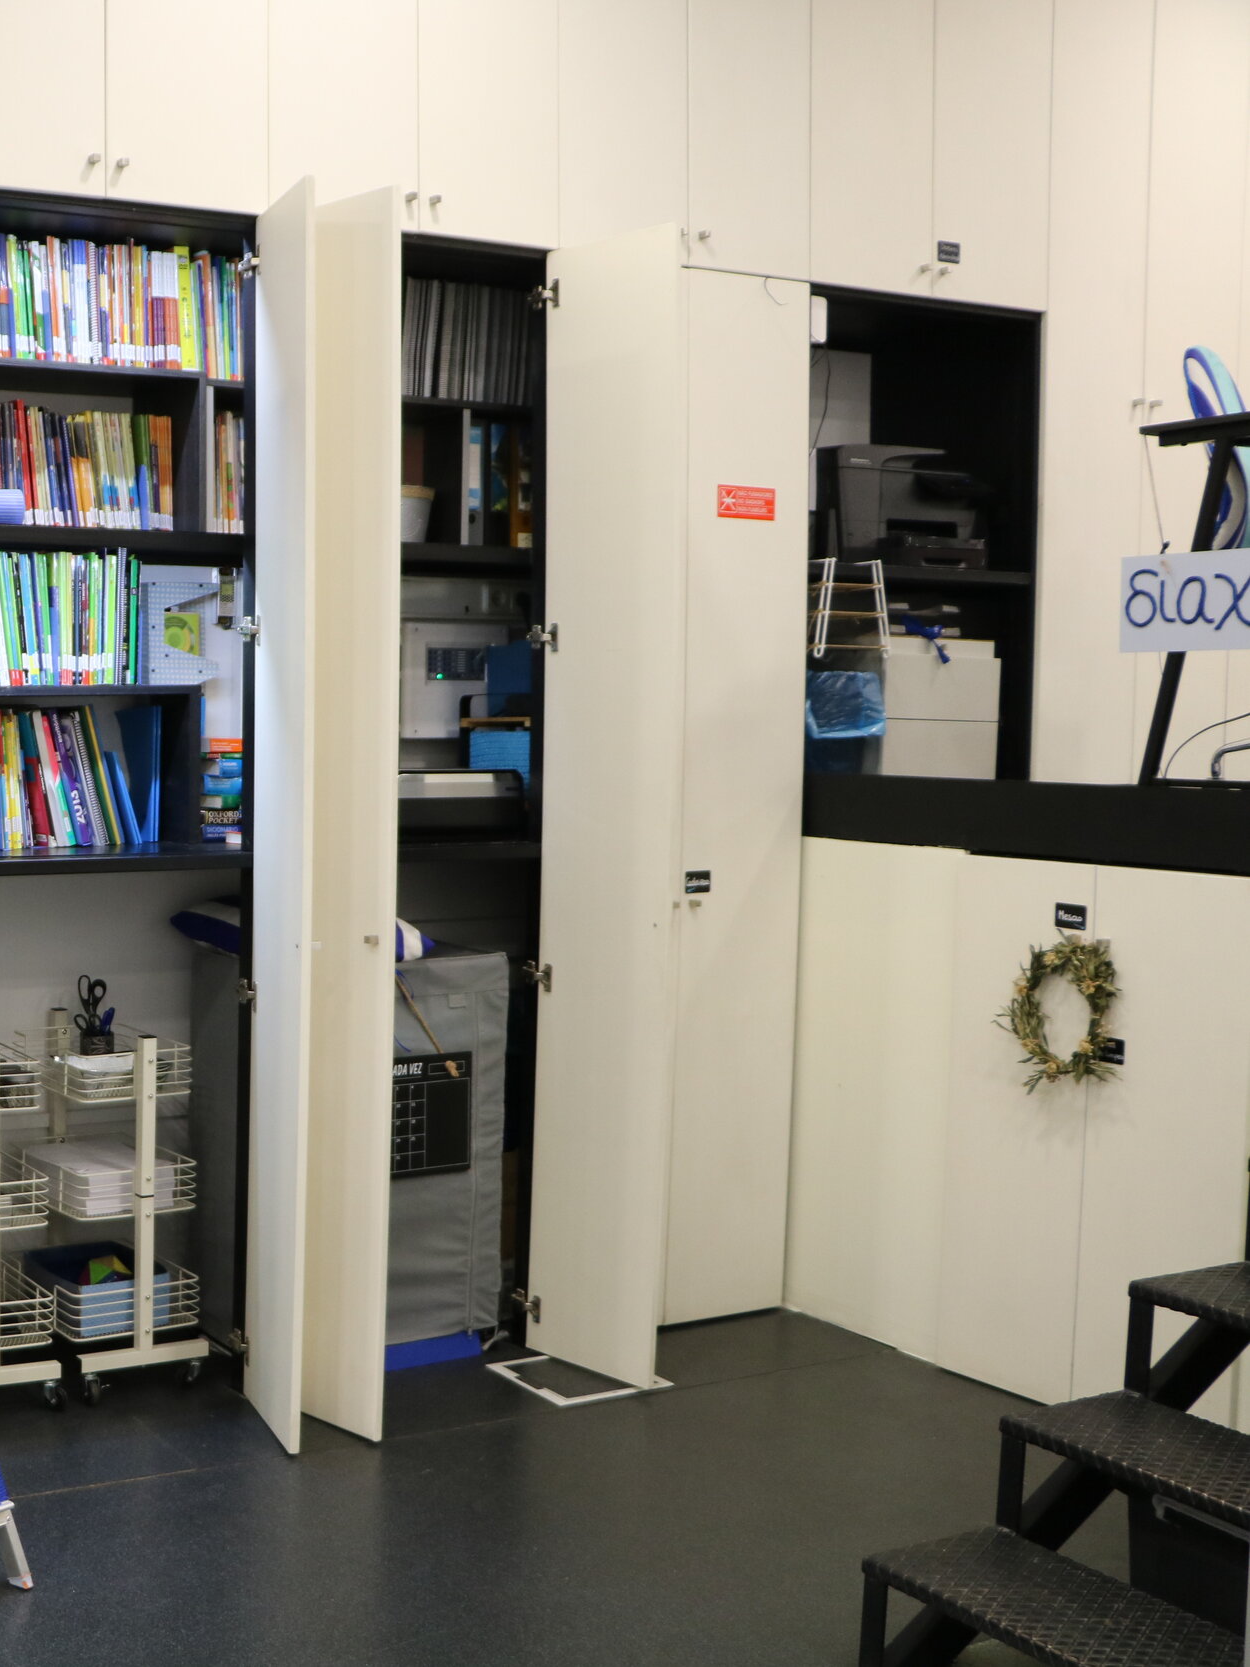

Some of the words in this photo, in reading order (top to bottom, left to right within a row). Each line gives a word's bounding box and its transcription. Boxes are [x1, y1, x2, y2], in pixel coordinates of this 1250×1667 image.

[208, 810, 239, 818] OXFORD
[392, 1063, 408, 1076] ADA
[409, 1062, 423, 1075] VEZ
